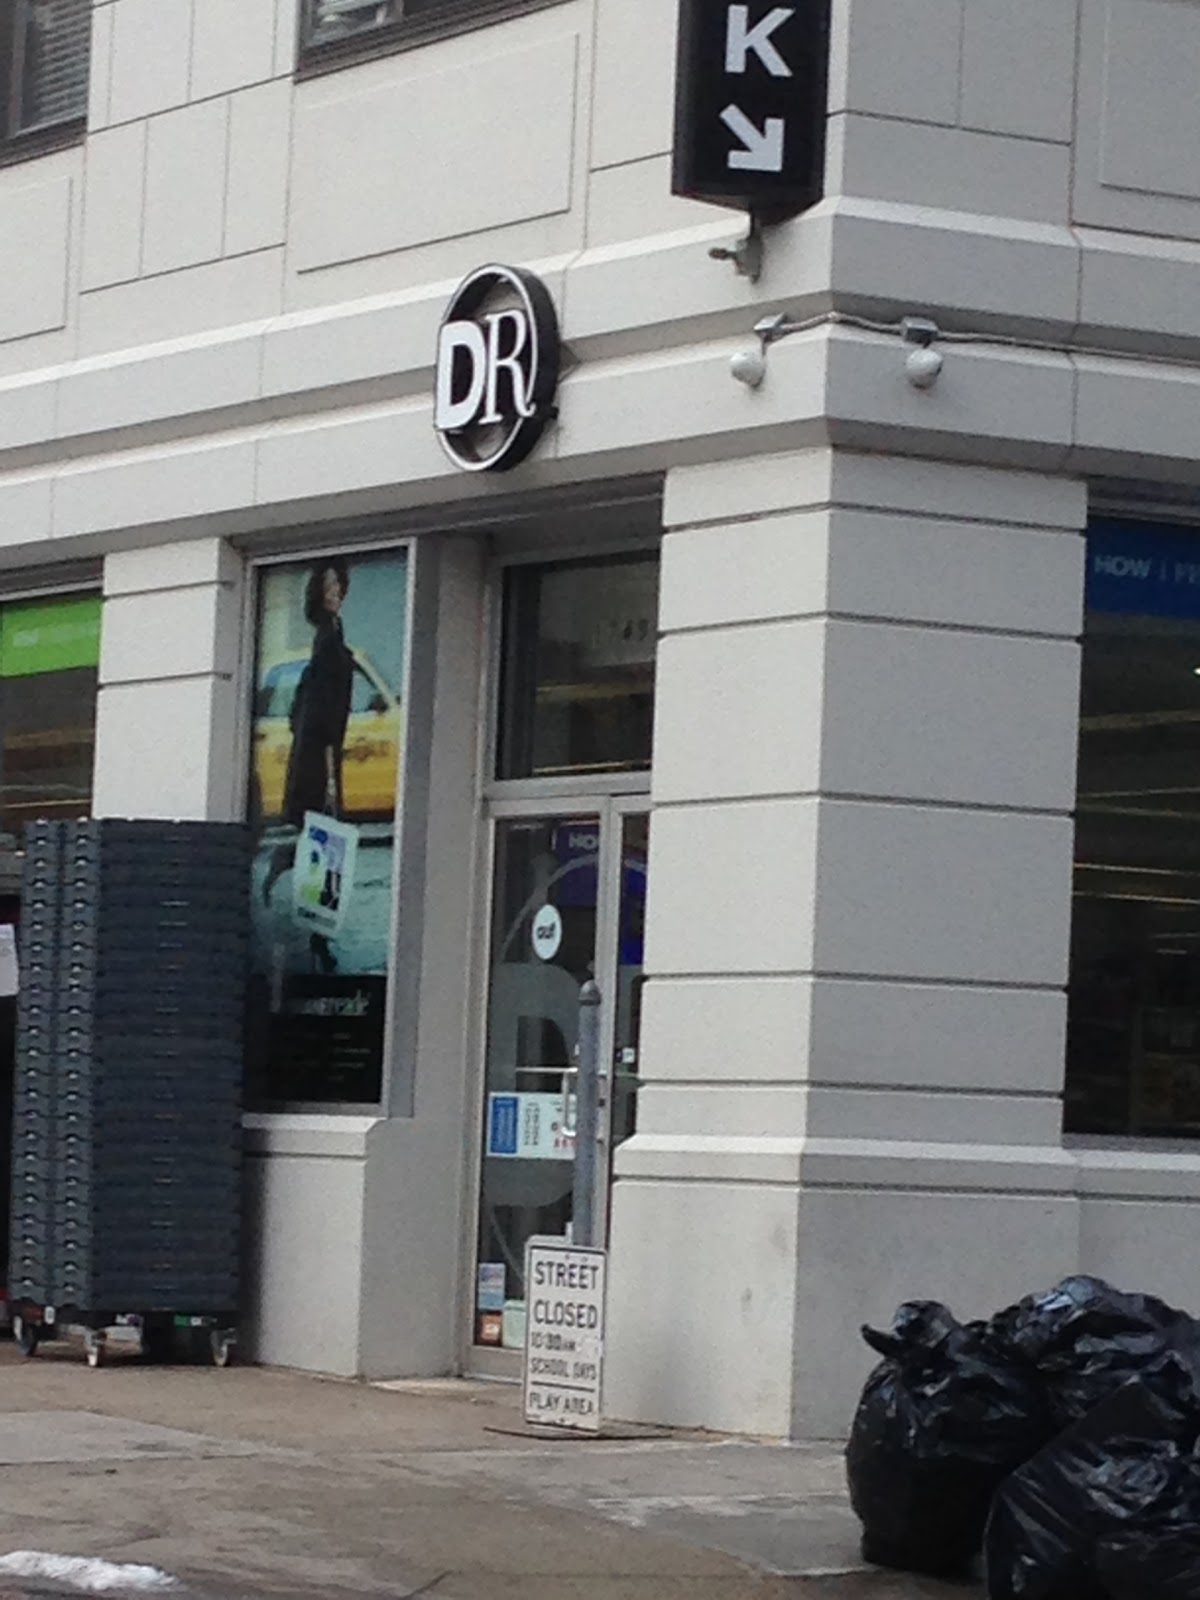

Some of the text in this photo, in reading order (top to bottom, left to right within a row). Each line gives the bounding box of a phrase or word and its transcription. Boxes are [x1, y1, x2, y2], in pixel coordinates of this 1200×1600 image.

[724, 4, 795, 78] K
[434, 308, 536, 430] DR
[1094, 555, 1153, 579] HOW
[535, 1261, 599, 1290] STREET
[534, 1299, 597, 1329] CLOSED
[530, 1357, 597, 1380] SCHOOL DAYS
[529, 1392, 594, 1416] PLAY AREA
